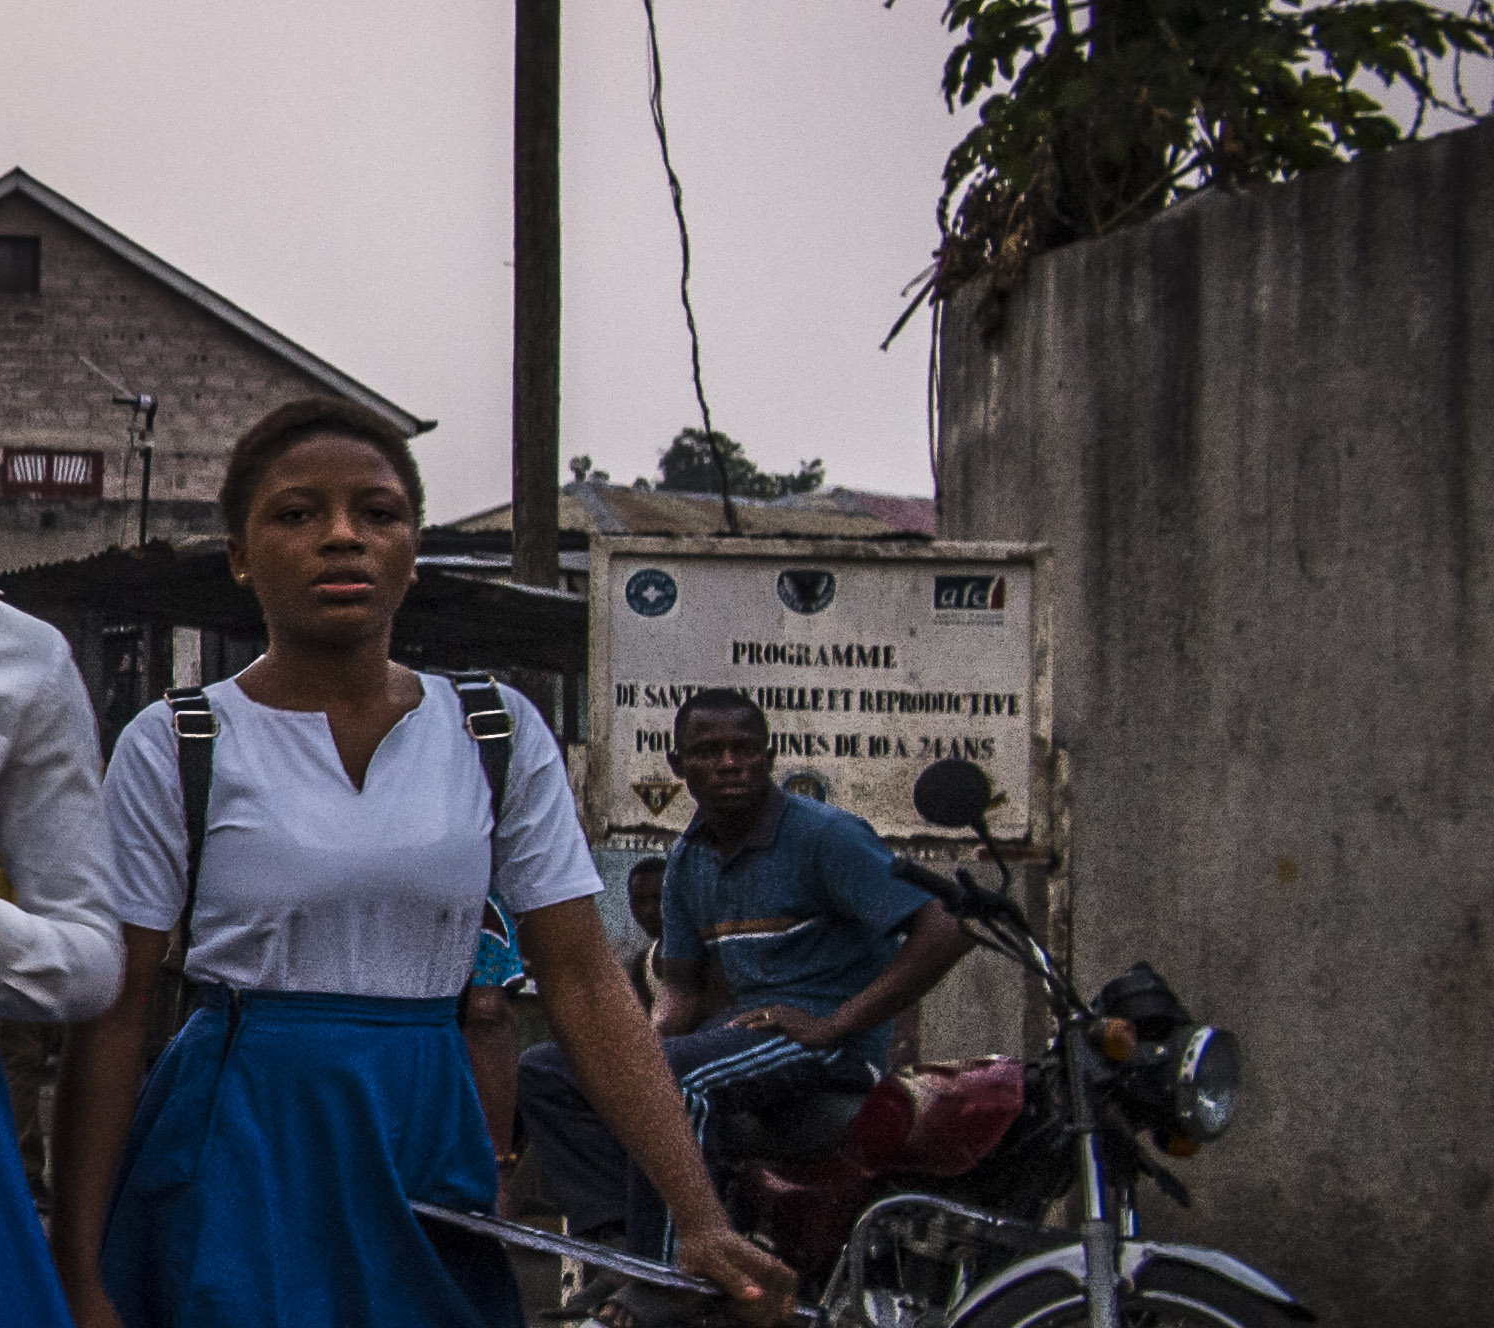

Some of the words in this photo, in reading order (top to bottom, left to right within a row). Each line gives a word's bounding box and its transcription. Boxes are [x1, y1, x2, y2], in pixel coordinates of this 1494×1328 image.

[732, 640, 897, 669] PROGRAMME
[616, 683, 637, 708] DE
[644, 683, 708, 708] SANT
[827, 688, 855, 713] ET
[859, 690, 1020, 716] REPRODUCTIVE
[834, 733, 861, 758] DE
[946, 736, 996, 761] ANS
